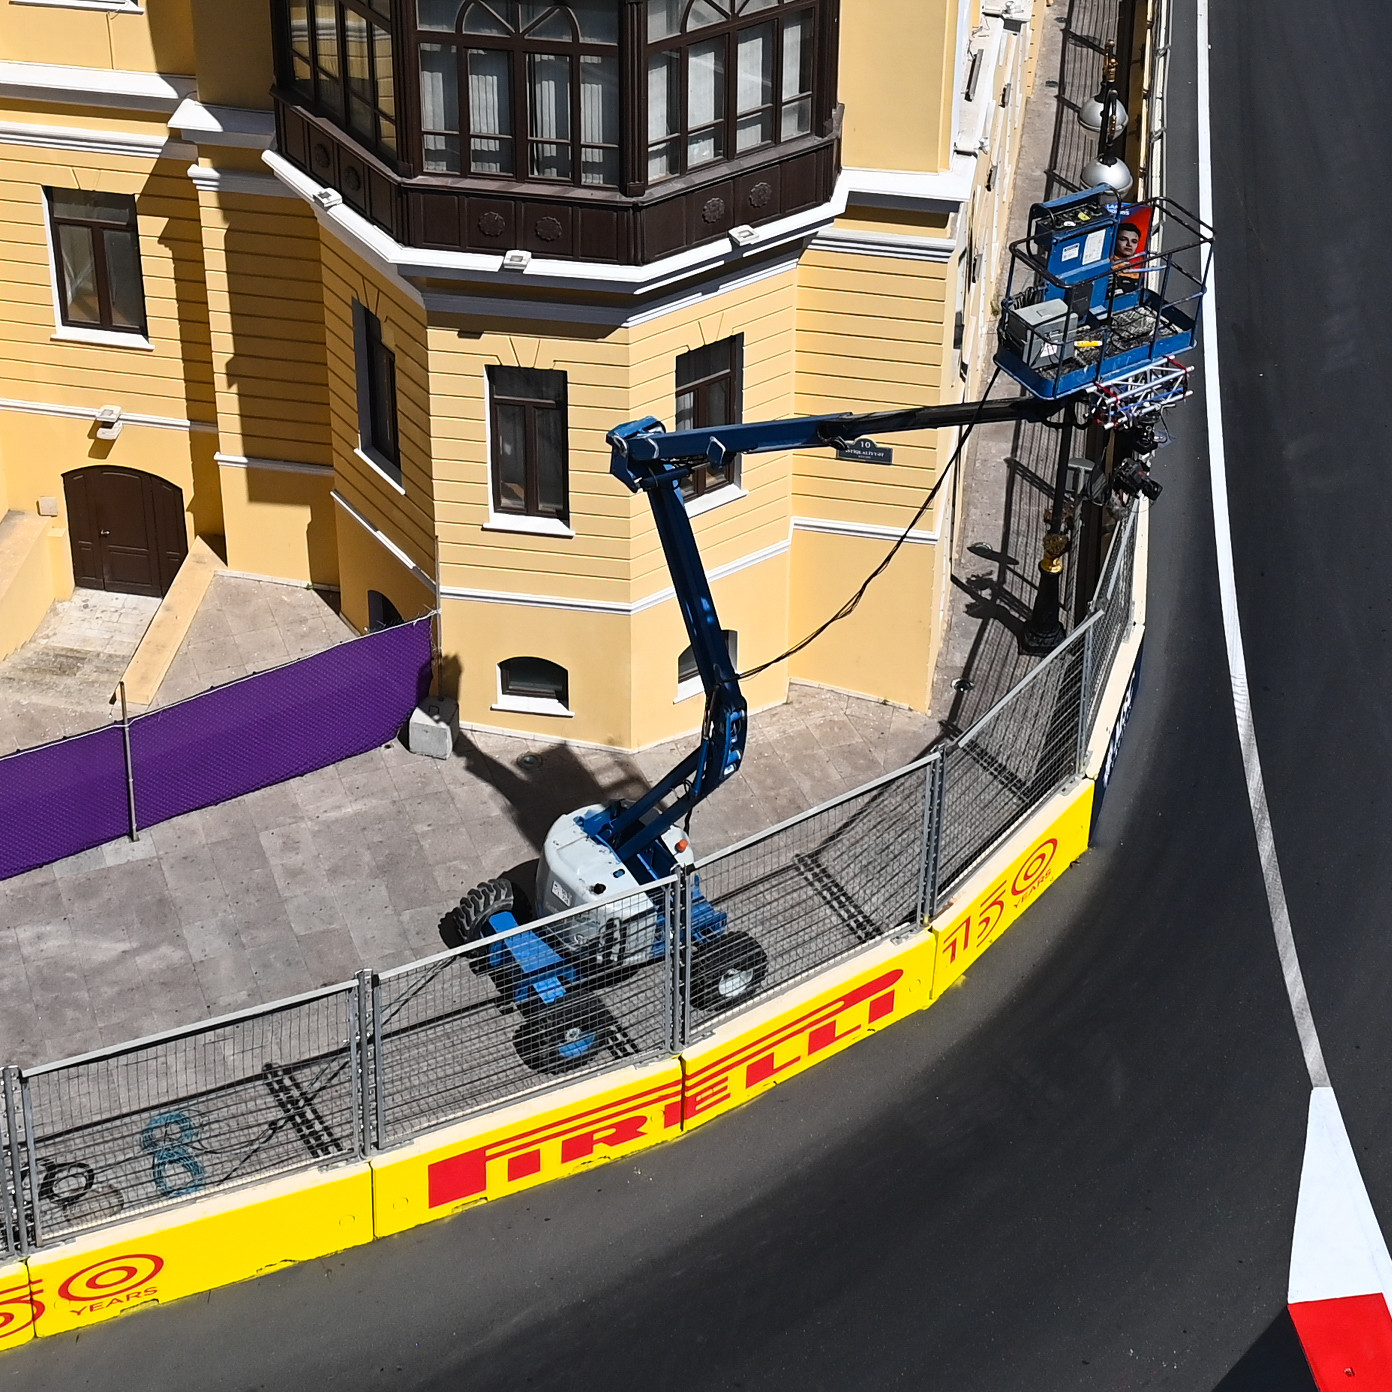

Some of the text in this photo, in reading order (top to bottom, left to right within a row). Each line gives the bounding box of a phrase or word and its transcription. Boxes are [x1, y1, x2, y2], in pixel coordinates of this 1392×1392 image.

[1014, 868, 1051, 908] YEARS
[428, 969, 904, 1209] PIRELLI
[70, 1287, 158, 1316] YEARS
